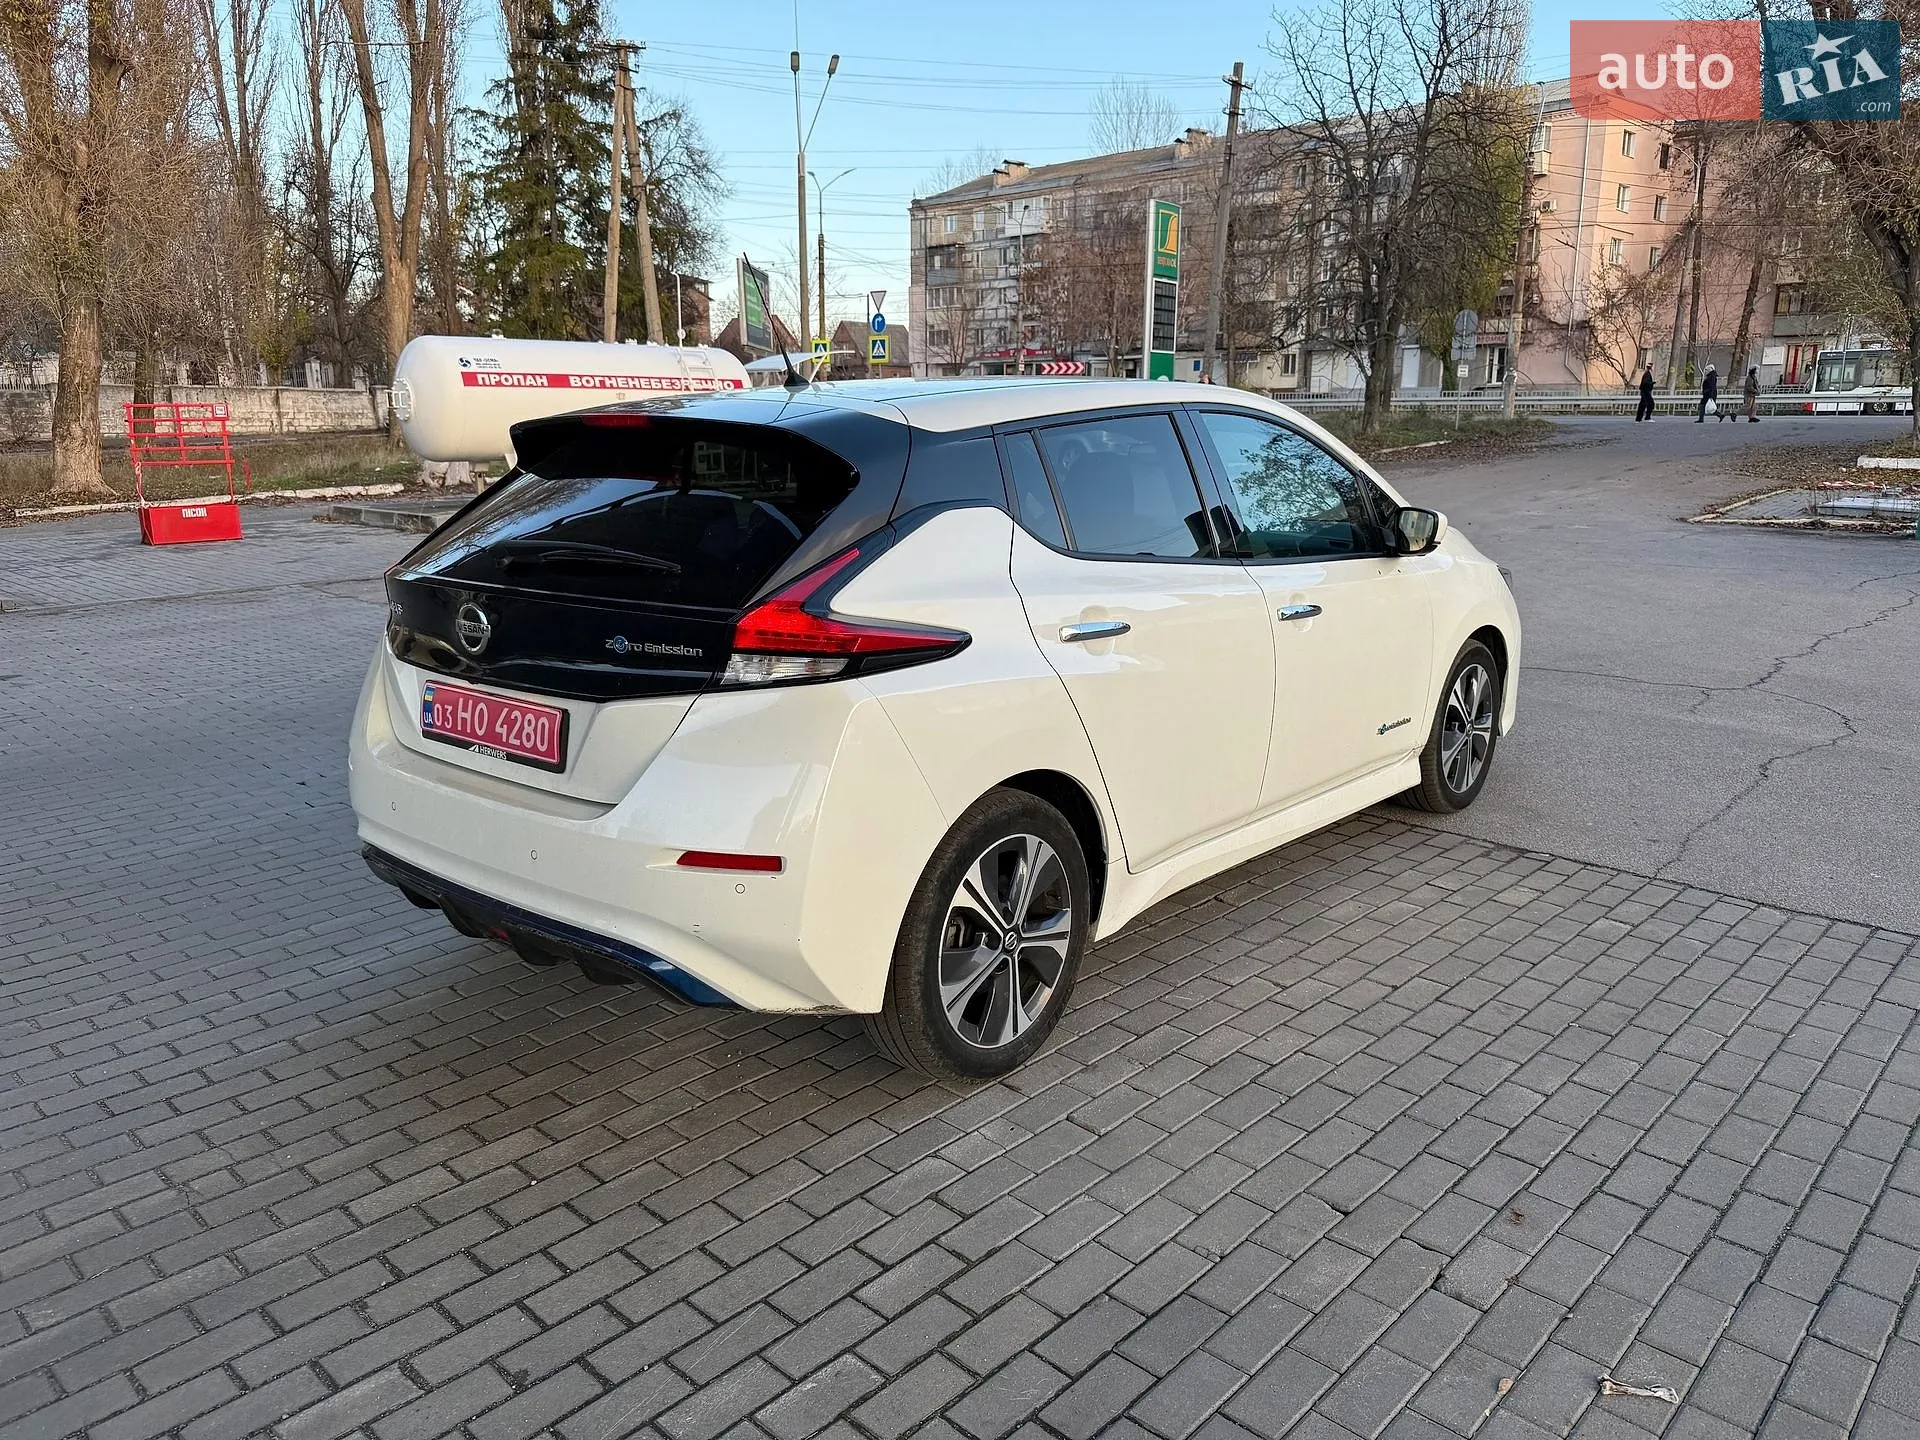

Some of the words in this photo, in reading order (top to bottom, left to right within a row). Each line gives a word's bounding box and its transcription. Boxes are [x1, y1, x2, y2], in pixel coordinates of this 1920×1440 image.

[476, 373, 549, 387] ПРОПАН
[423, 711, 433, 724] UA
[434, 703, 453, 729] 03
[457, 697, 489, 737] HO
[495, 707, 550, 752] 4280
[480, 745, 507, 760] HERWERS
